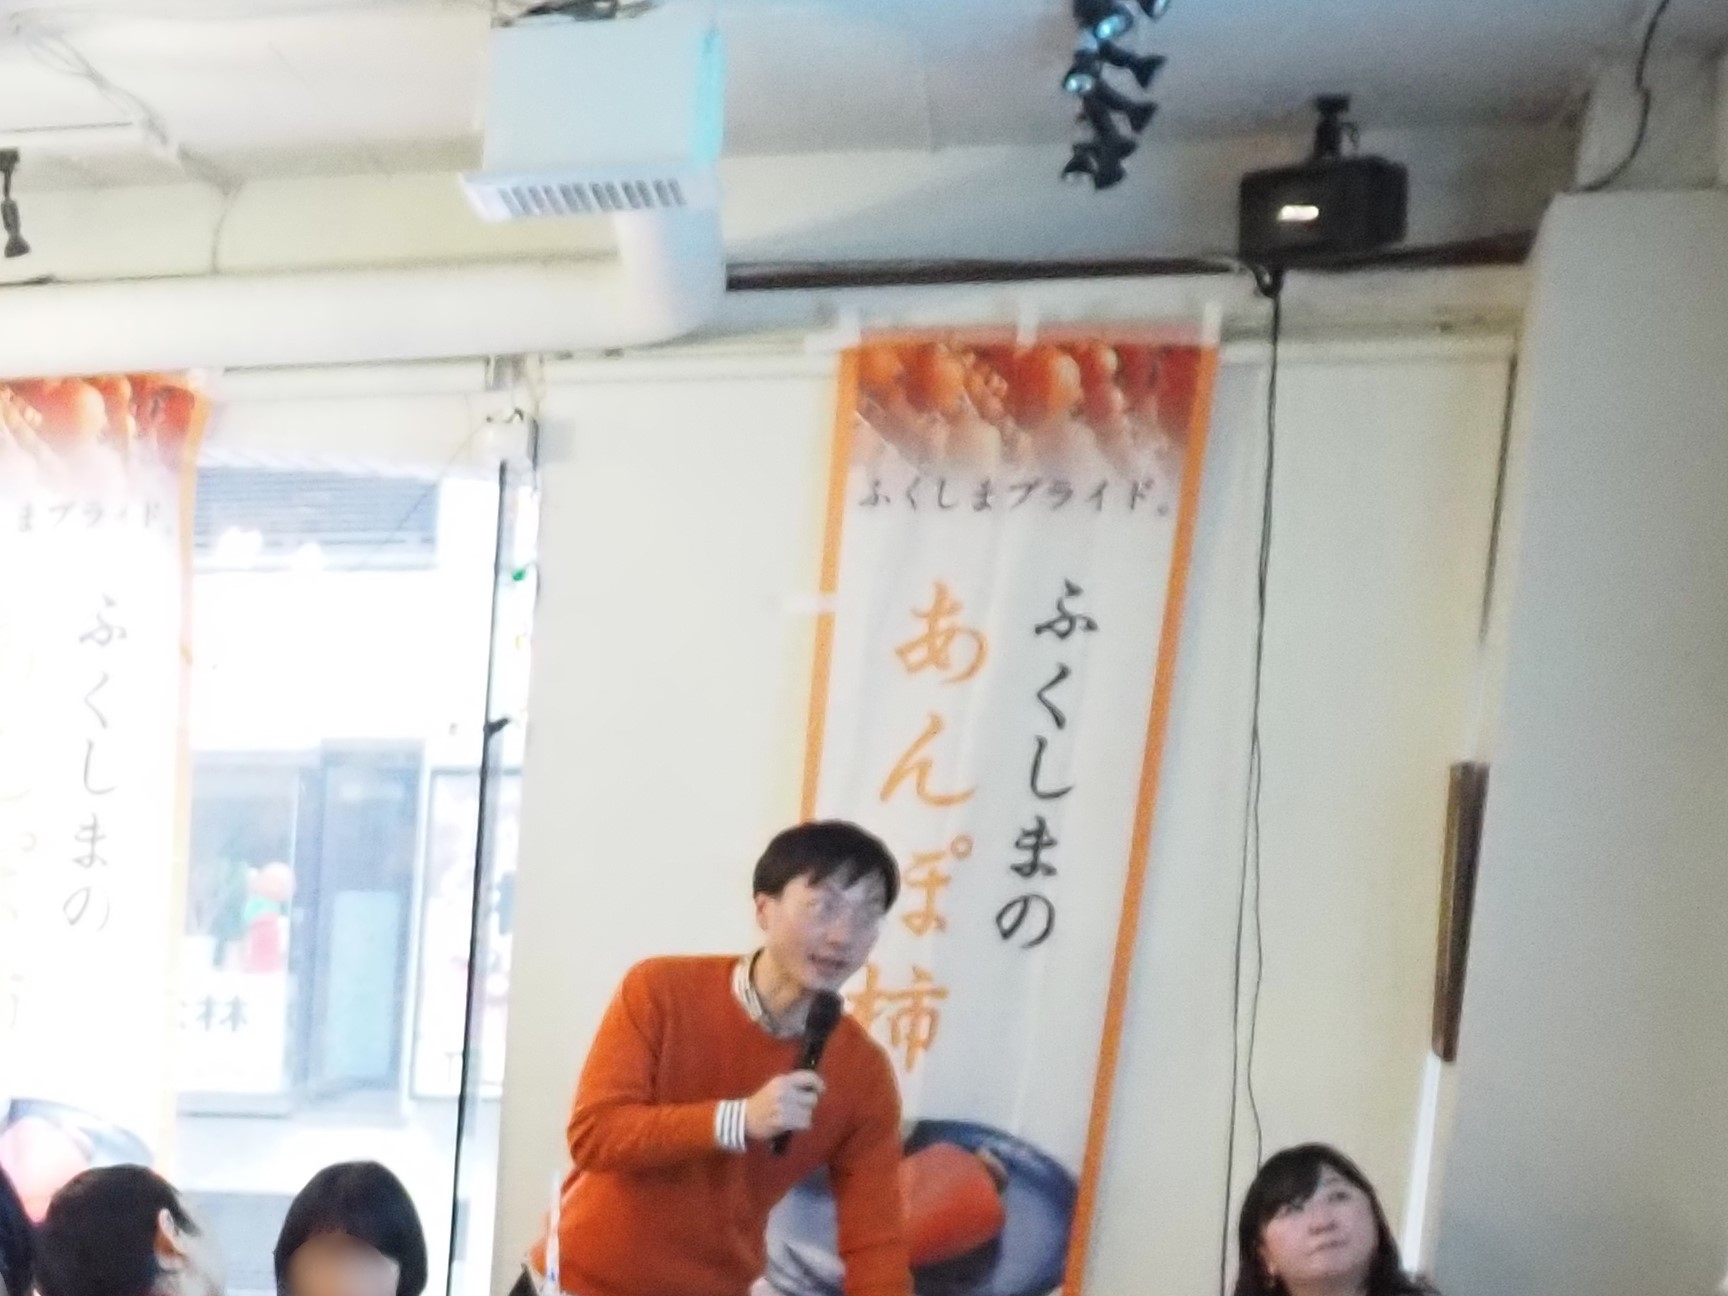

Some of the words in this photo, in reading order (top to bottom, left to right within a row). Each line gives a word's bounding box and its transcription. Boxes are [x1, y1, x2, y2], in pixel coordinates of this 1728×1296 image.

[62, 594, 128, 932] ふくしまの
[994, 577, 1100, 951] ふくしまの
